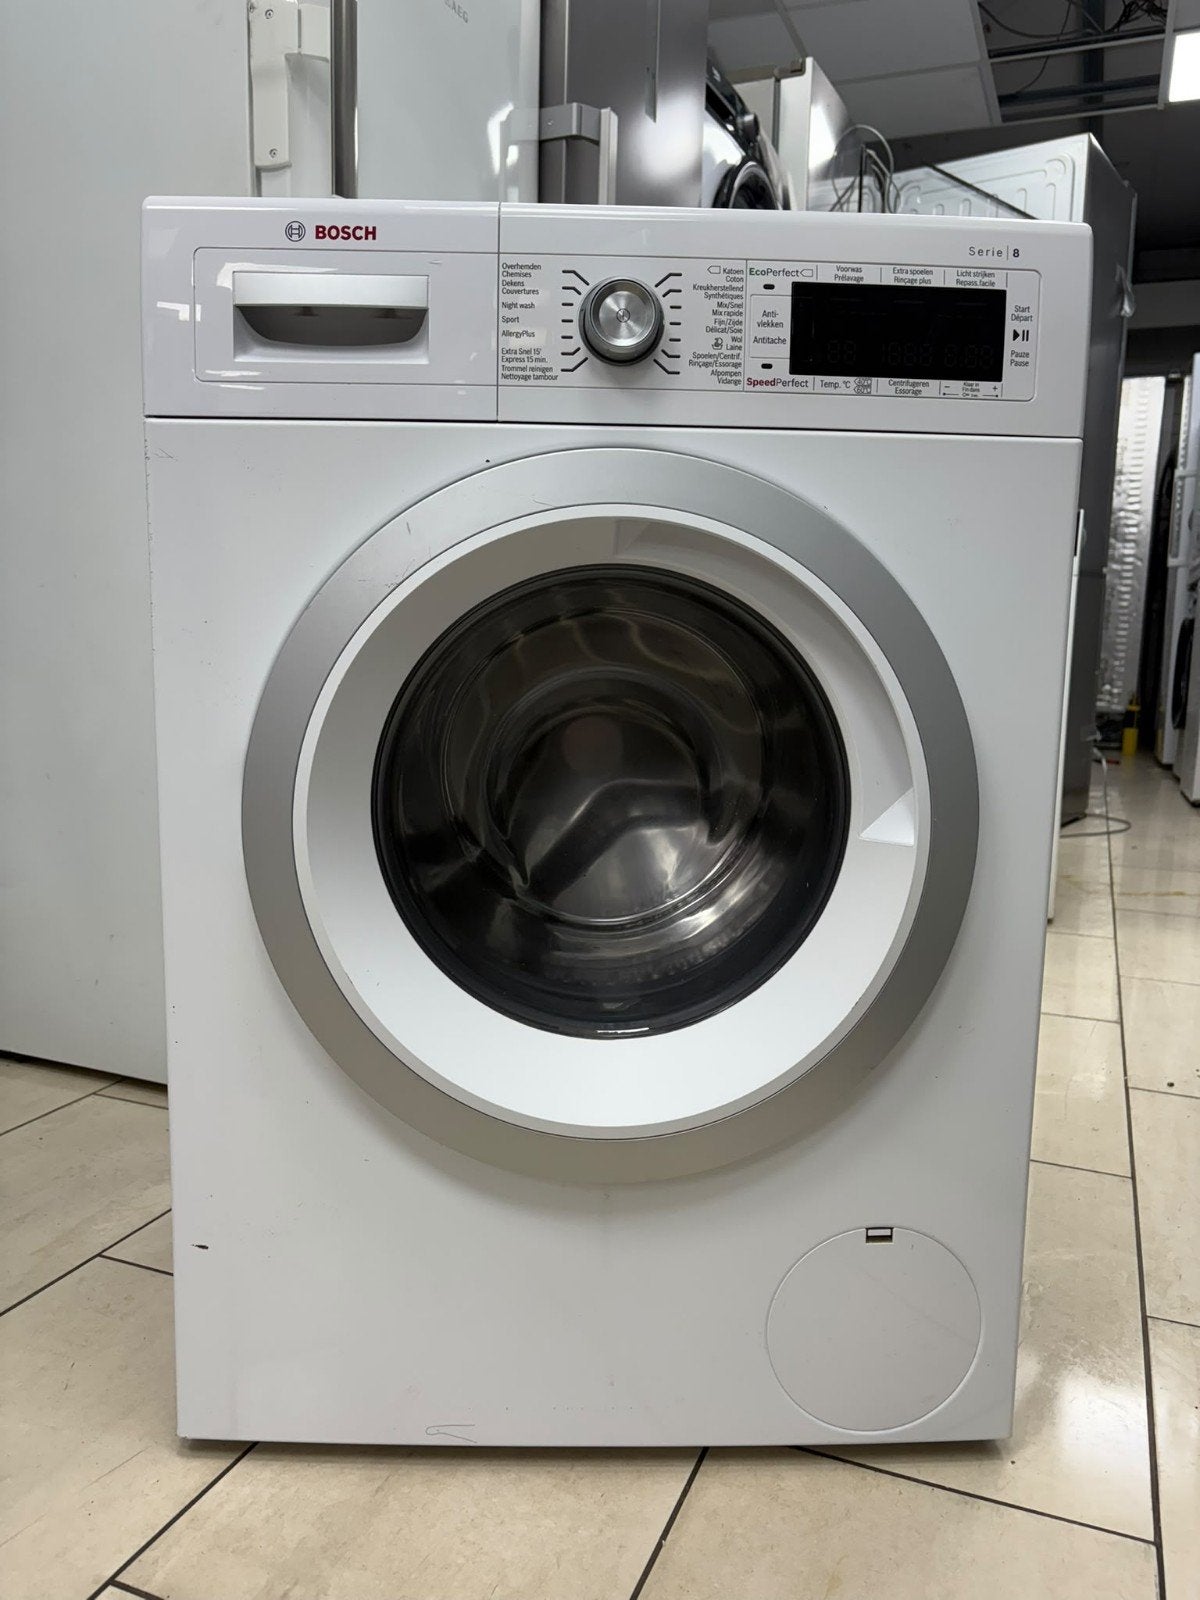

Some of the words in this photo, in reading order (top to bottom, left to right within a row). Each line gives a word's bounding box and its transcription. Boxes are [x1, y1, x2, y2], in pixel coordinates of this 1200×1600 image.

[315, 225, 376, 240] BOSCH
[969, 246, 1003, 257] Serie
[1012, 248, 1020, 258] 8
[502, 262, 541, 270] Overhemden
[836, 265, 862, 273] Voorwas
[749, 267, 800, 277] EcoPerfect
[892, 267, 908, 275] Extra
[910, 268, 933, 276] spoelen
[973, 270, 995, 279] strijken
[834, 274, 864, 283] Prélavage
[894, 276, 918, 285] Rinçage
[919, 277, 932, 285] plus
[692, 284, 744, 292] Kreukherstellend
[704, 292, 744, 300] Synthétiques
[502, 302, 518, 310] Night
[717, 301, 743, 309] Mix/Snel
[1014, 305, 1030, 313] Start
[723, 310, 743, 318] rapide
[762, 310, 779, 318] Anti-
[1011, 313, 1033, 323] Départ
[502, 316, 520, 324] Sport
[714, 318, 743, 327] Fijn/Zijde
[757, 320, 784, 328] vlekken
[502, 330, 535, 338] AllergyPlus
[706, 326, 743, 334] Délicat/Soie
[753, 336, 787, 344] Antitache
[726, 343, 742, 351] Laine
[692, 352, 741, 360] Spoelen/Centrif.
[1010, 350, 1030, 358] Pauze
[502, 356, 526, 364] Express
[688, 360, 742, 368] Rinçage/Essorage
[1010, 358, 1029, 367] Pause
[529, 365, 553, 373] reinigen
[502, 373, 531, 381] Nettoyage
[711, 370, 742, 378] Afpompen
[717, 377, 742, 386] Vidange
[746, 377, 808, 388] SpeedPerfect
[820, 380, 841, 389] Temp.
[888, 380, 929, 388] Centrifugeren
[895, 387, 922, 396] Essorage
